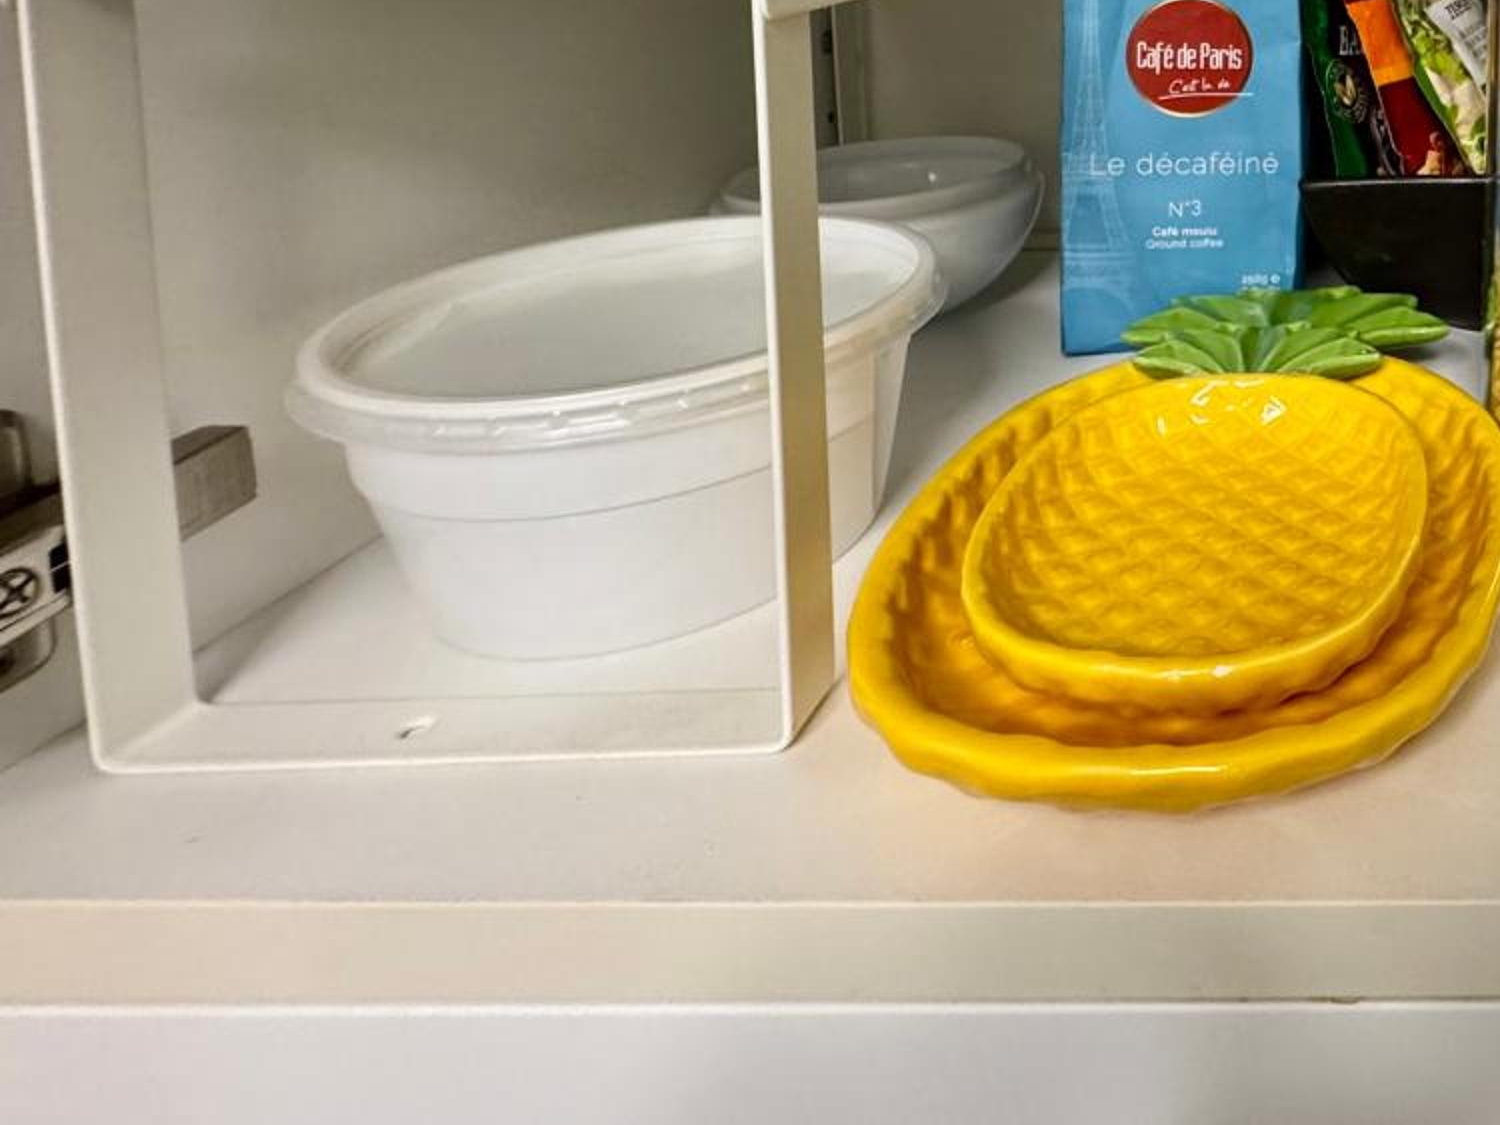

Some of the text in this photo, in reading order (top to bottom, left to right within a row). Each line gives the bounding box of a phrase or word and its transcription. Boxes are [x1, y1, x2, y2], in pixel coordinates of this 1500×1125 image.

[1136, 41, 1242, 75] Café de Paris
[1089, 151, 1280, 176] Le décaféiné
